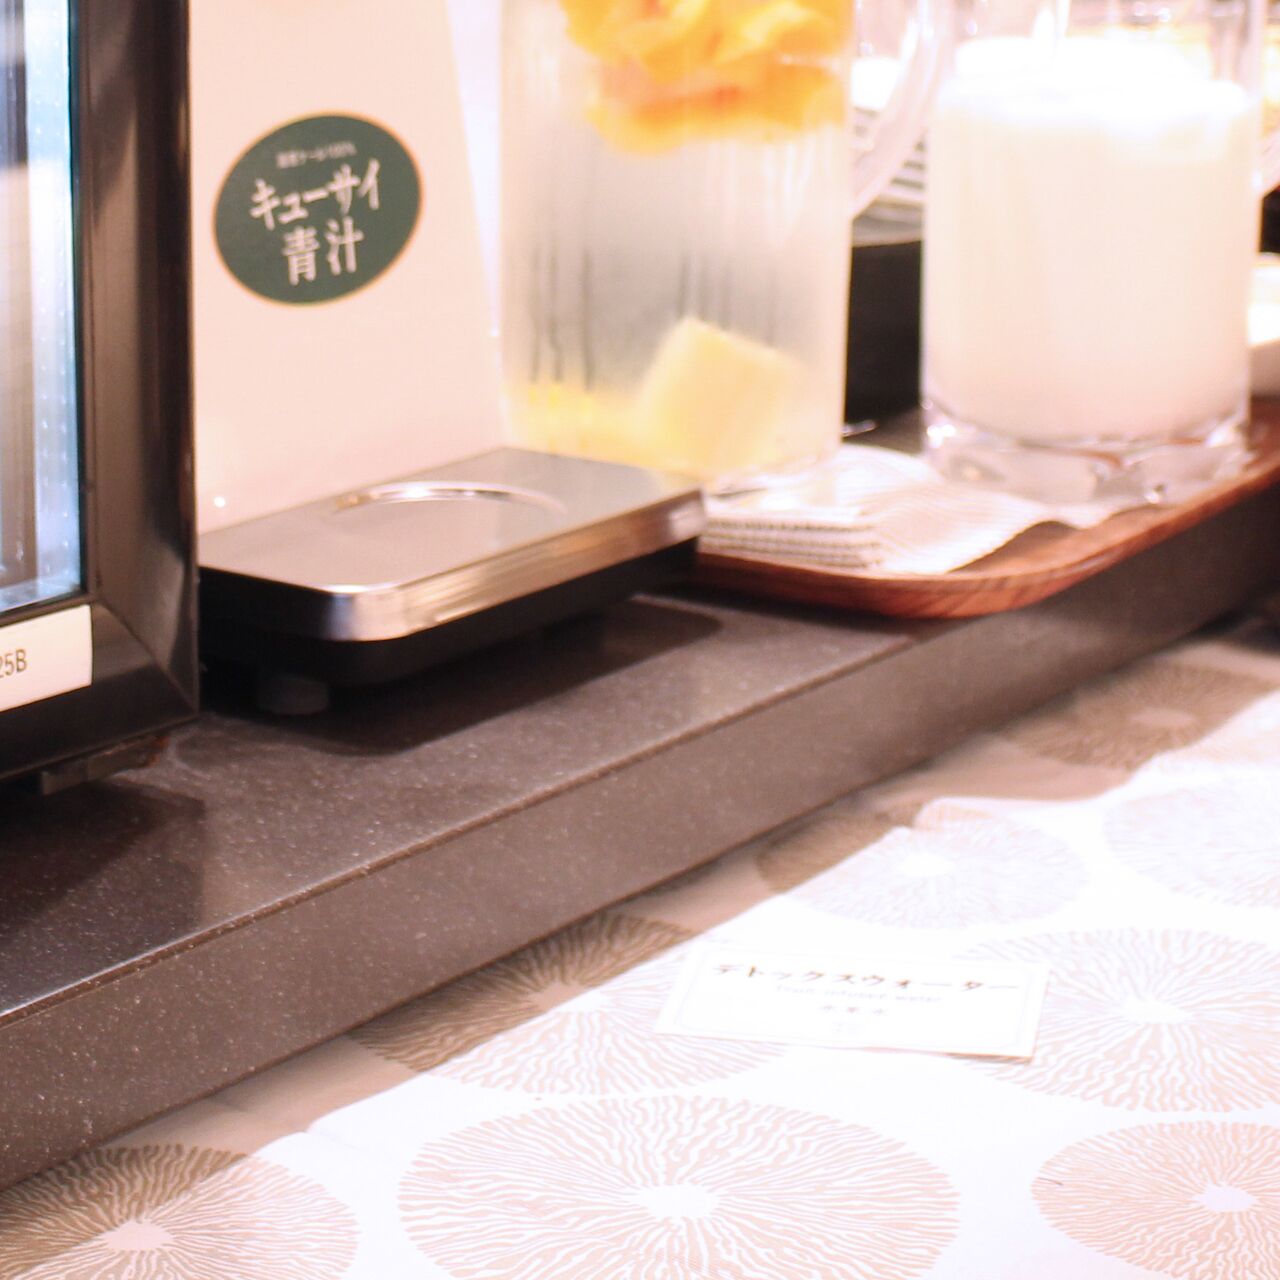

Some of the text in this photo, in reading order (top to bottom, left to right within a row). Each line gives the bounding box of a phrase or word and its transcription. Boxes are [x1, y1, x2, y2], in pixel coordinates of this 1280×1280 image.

[249, 157, 381, 232] キューサイ
[281, 214, 365, 286] 青汁
